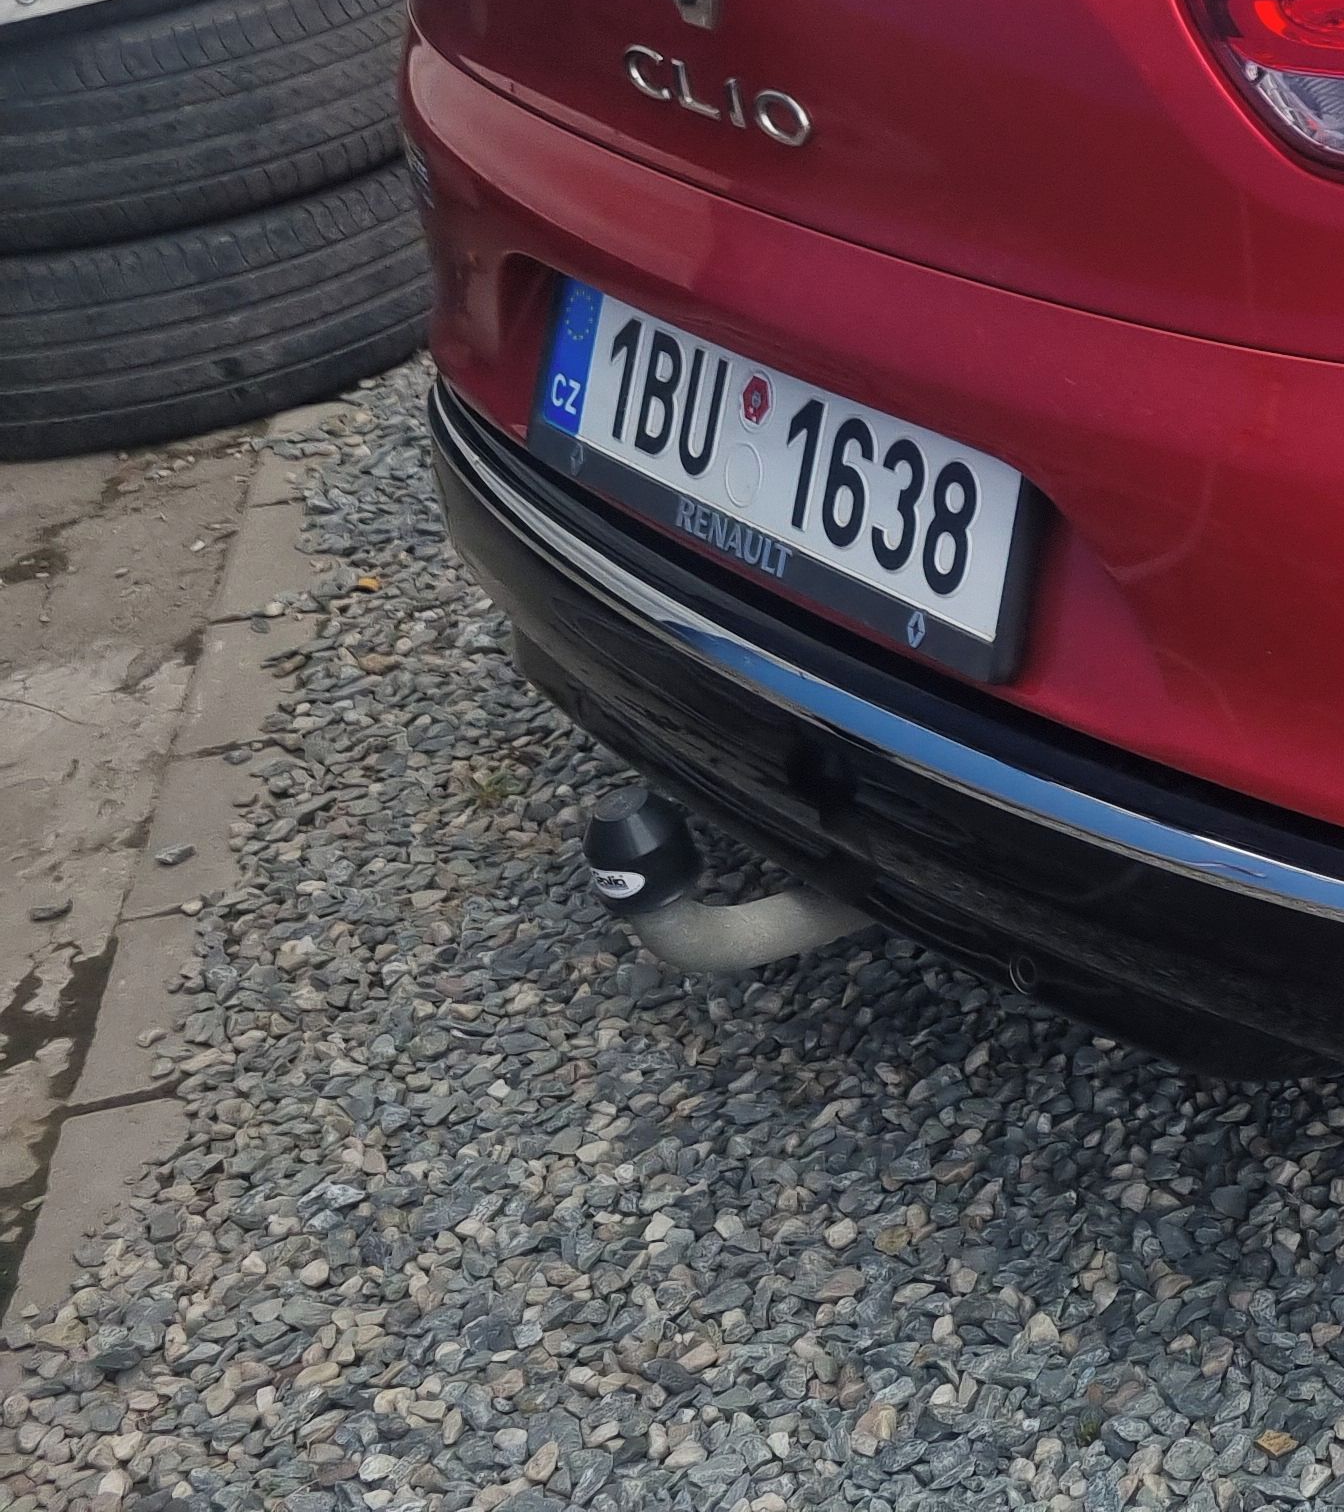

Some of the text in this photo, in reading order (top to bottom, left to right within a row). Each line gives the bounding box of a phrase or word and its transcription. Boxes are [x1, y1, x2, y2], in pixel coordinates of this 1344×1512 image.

[624, 44, 814, 148] CLIO
[550, 372, 581, 416] CZ
[610, 317, 979, 596] 1BU 1638
[674, 497, 793, 580] RENAULT
